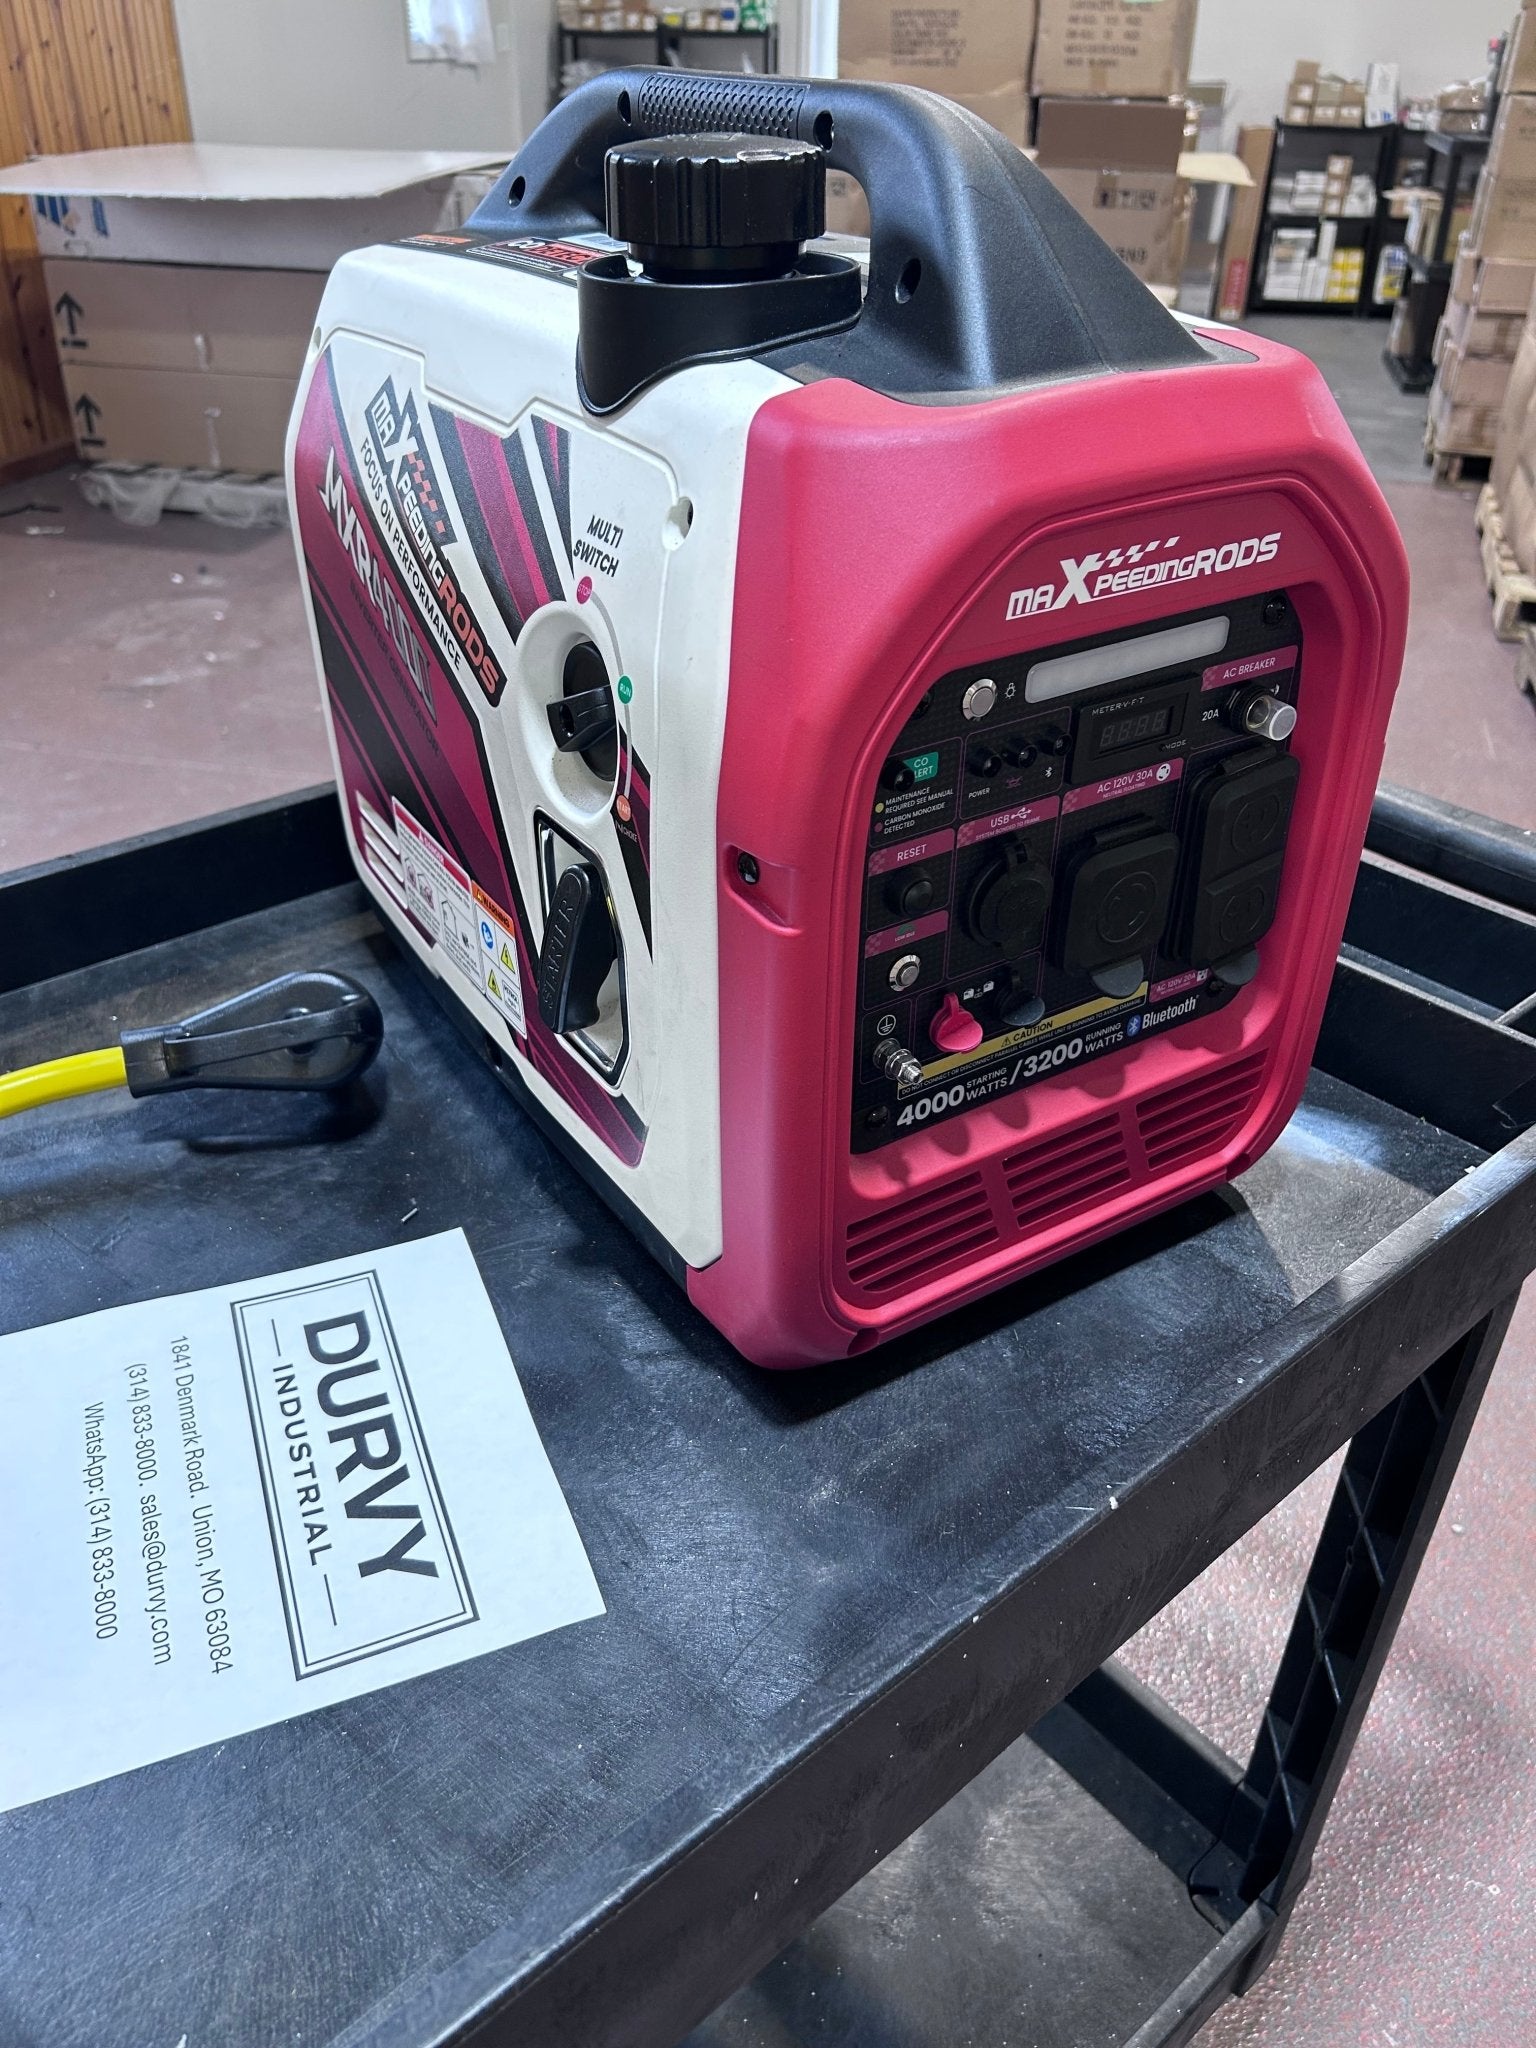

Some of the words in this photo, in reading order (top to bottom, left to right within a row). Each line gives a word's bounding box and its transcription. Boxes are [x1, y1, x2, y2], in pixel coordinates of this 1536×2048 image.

[586, 515, 624, 549] MULTI
[361, 436, 383, 499] FOCUS
[380, 502, 394, 533] ON
[393, 531, 461, 671] PERFORMANCE
[573, 540, 620, 578] SWITCH
[577, 583, 592, 597] STOP
[1223, 667, 1237, 679] AC
[1238, 657, 1276, 675] BREAKER
[620, 683, 632, 697] RUN
[1201, 708, 1219, 722] 20A
[913, 757, 929, 768] CO
[914, 766, 933, 779] LERT
[885, 786, 931, 806] MAINTENANCE
[968, 787, 991, 799] POWER
[1097, 783, 1112, 794] AC
[1113, 773, 1135, 789] 120V
[1135, 768, 1153, 781] 30A
[884, 812, 912, 826] CARBON
[912, 801, 946, 818] MONOXIDE
[885, 800, 916, 815] REQUIRED
[916, 796, 928, 806] SEE
[928, 788, 954, 802] MANUAL
[884, 820, 916, 835] DETECTED
[990, 813, 1010, 828] USB
[896, 843, 928, 862] RESET
[1013, 1020, 1054, 1042] CAUTION
[1084, 1031, 1123, 1054] WATTS
[1085, 1022, 1122, 1042] RUNNING
[924, 1072, 950, 1086] CONNECT
[960, 1053, 994, 1073] DISCONNECT
[966, 1067, 1007, 1088] STARTING
[965, 1077, 1008, 1101] WATTS
[897, 1084, 965, 1126] 4000
[170, 1335, 192, 1371] 1841
[125, 1362, 146, 1403] (314)
[175, 1374, 200, 1448] Denmark
[84, 1401, 106, 1494] WhatsApp:
[132, 1406, 158, 1488] 833-8000.
[303, 1309, 439, 1579] DURVY
[184, 1448, 208, 1499] Road.
[273, 1364, 333, 1567] INDUSTRIAL
[86, 1497, 112, 1545] (314)
[192, 1505, 214, 1568] Union,
[92, 1546, 118, 1640] 833-8000
[140, 1494, 171, 1665] sales@durvy.com
[201, 1570, 225, 1603] MO
[206, 1608, 233, 1674] 63084
